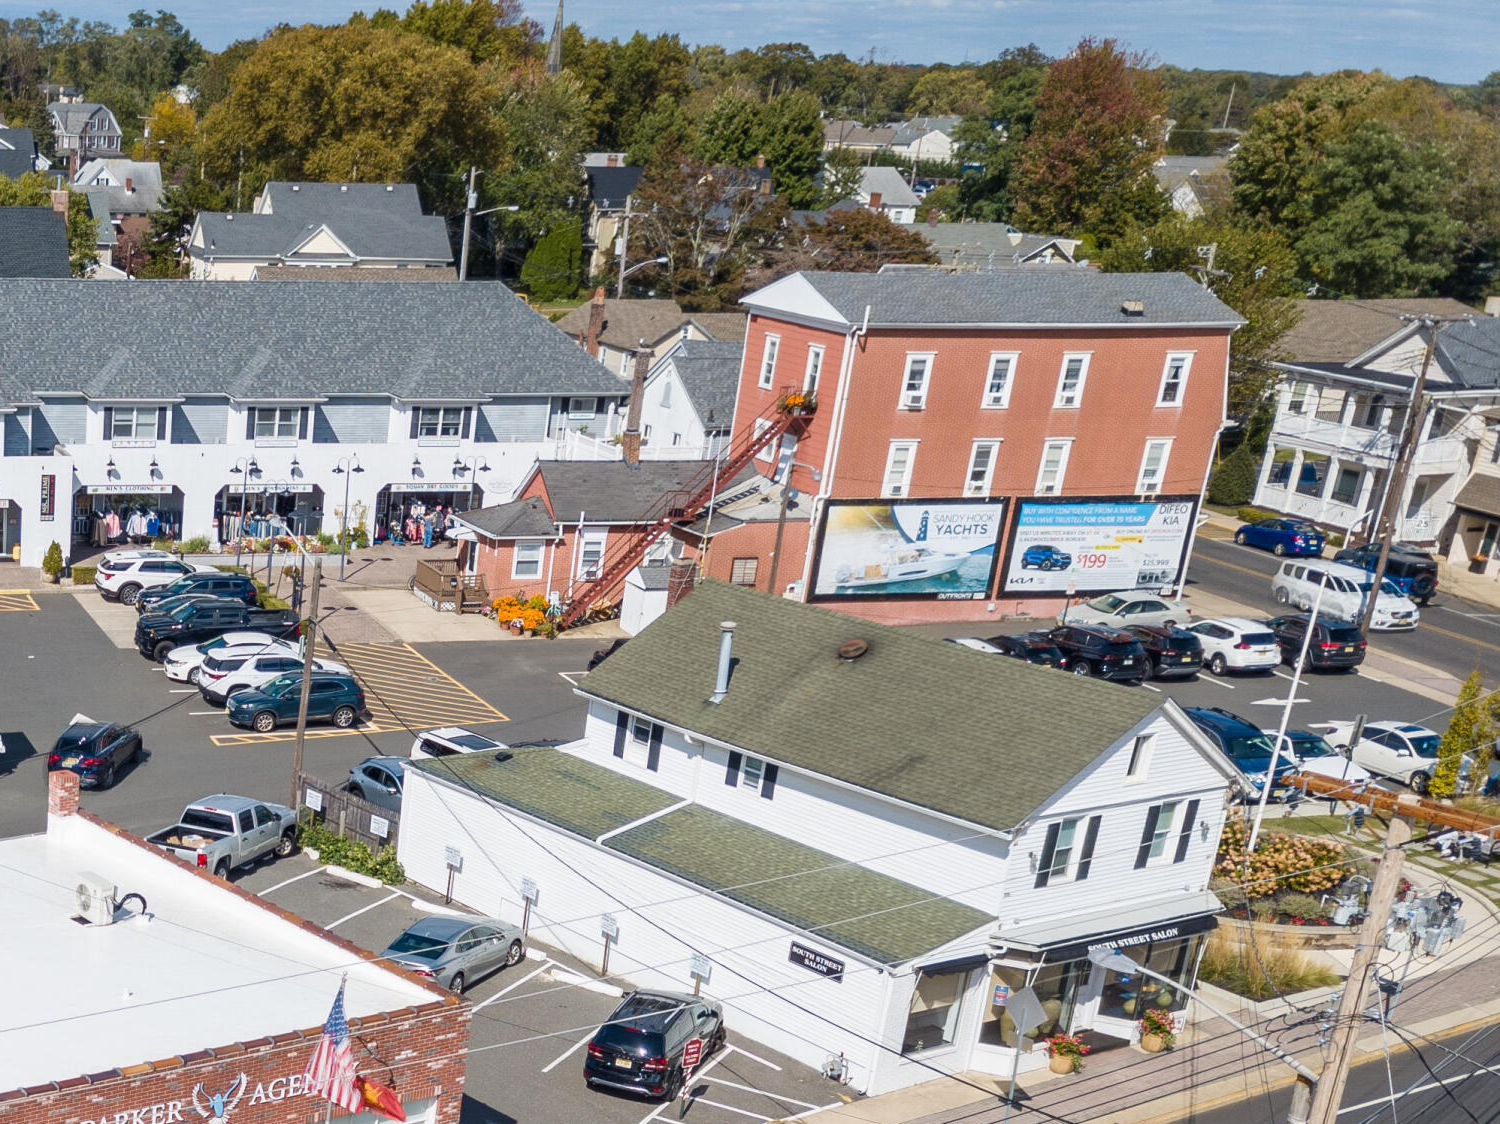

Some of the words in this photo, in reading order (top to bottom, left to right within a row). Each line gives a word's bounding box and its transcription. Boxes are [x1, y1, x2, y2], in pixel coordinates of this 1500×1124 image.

[1055, 506, 1093, 514] CONFIDENCE
[1159, 504, 1188, 514] DIFEO
[933, 513, 965, 523] SANDY
[967, 513, 994, 522] HOOK
[1162, 516, 1179, 525] KIA
[936, 524, 988, 535] YACHTS
[1076, 553, 1107, 569] $199
[1118, 933, 1150, 948] STREET
[1151, 928, 1179, 941] SALON
[792, 946, 815, 960] SOUTH
[815, 955, 843, 972] STREET
[804, 958, 827, 973] SALON
[249, 1073, 323, 1106] AGEN
